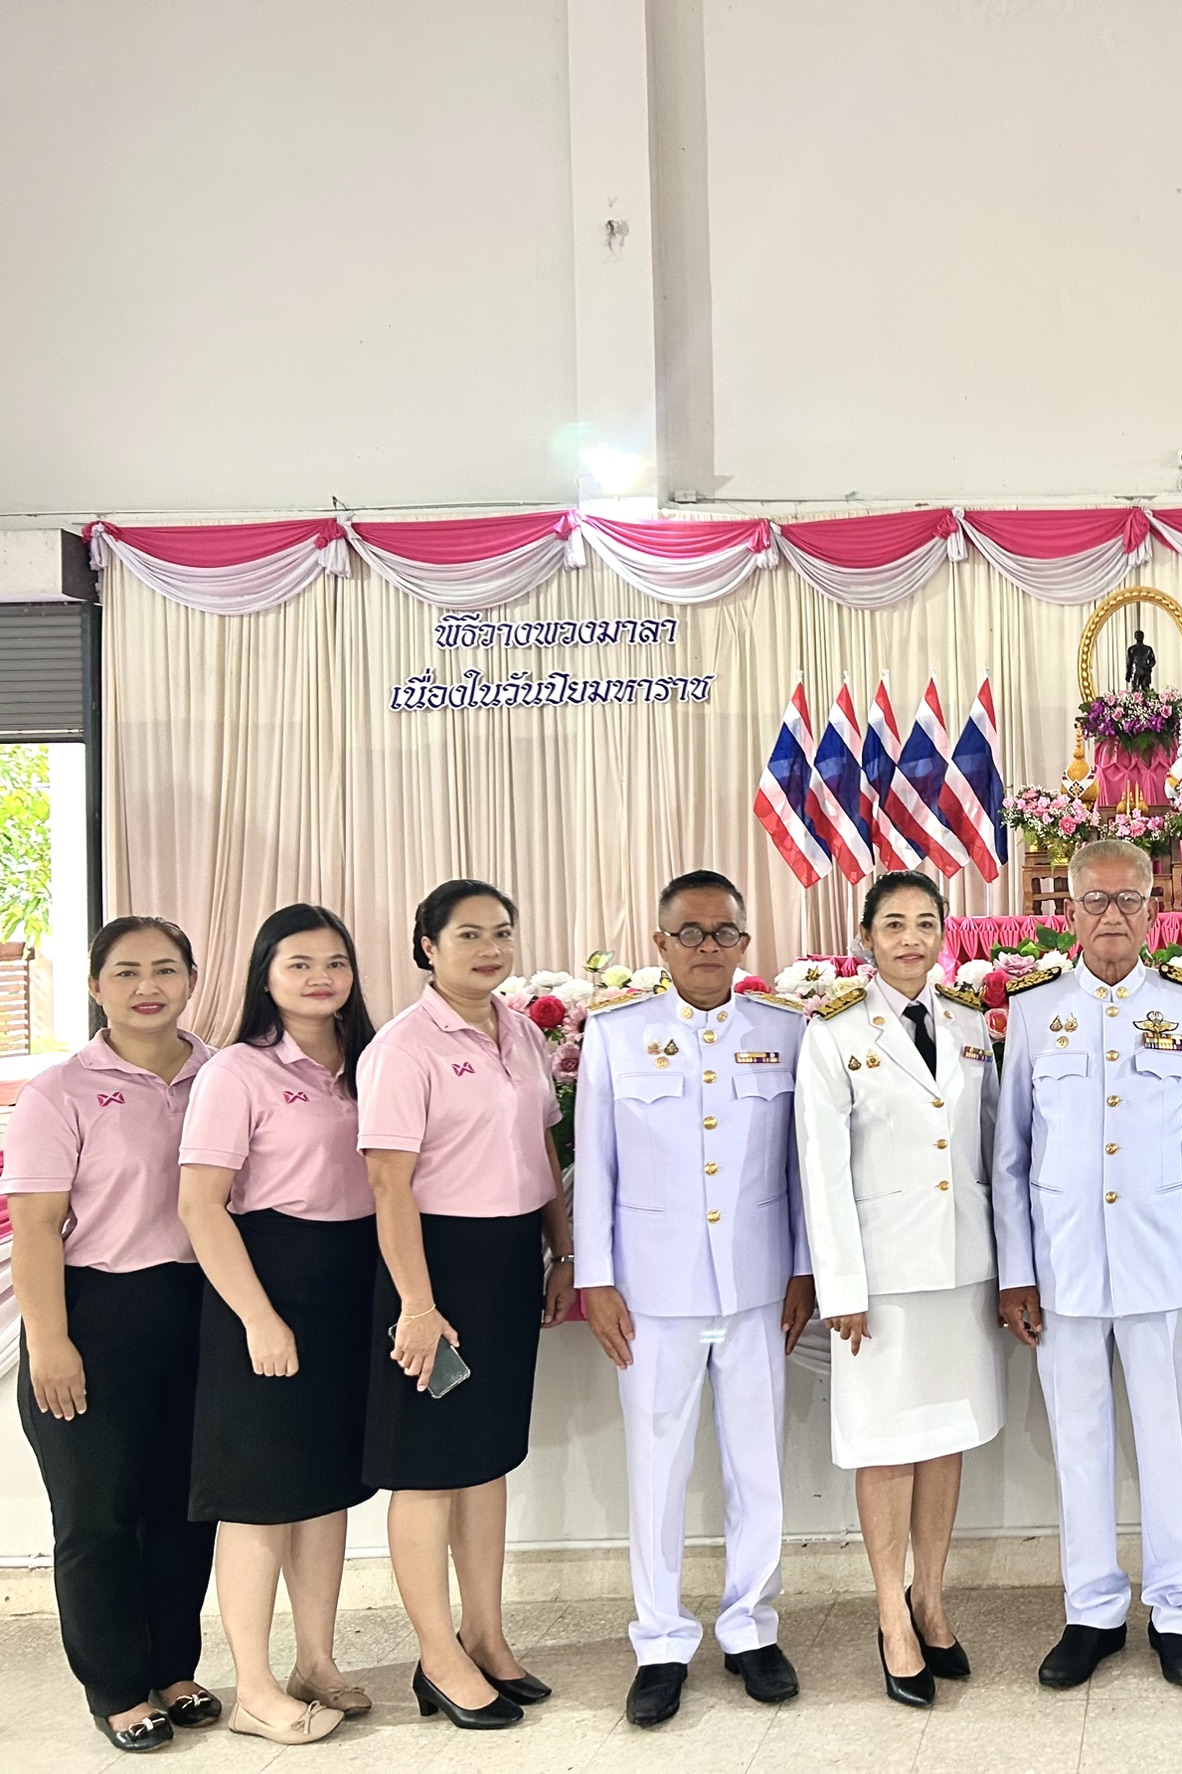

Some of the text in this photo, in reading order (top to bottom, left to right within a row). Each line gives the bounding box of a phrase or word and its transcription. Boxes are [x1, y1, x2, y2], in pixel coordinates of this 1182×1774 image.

[435, 613, 678, 648] พิธีวางพวงมาลา
[390, 668, 716, 711] เนื่องในวันปิยมหาราช
